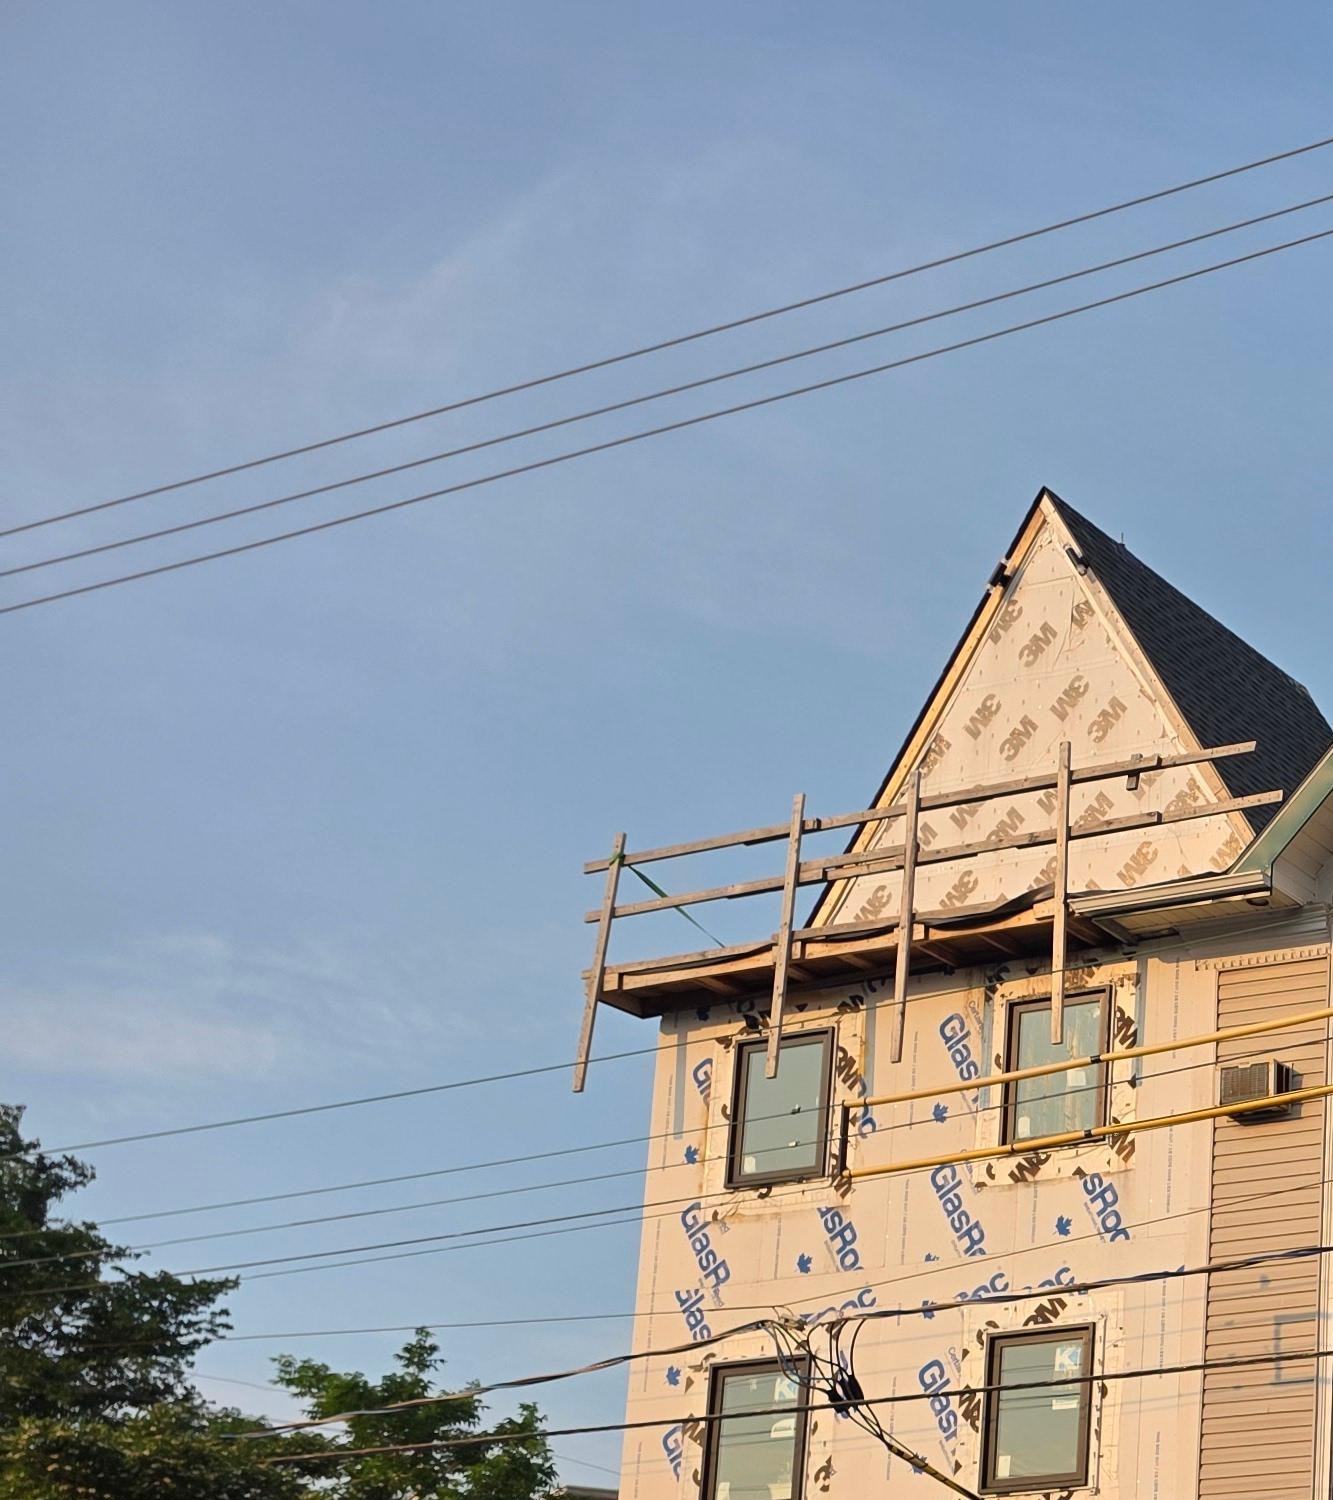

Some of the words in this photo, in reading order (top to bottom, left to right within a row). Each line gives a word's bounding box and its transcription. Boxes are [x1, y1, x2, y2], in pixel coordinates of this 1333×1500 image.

[1019, 621, 1058, 667] 3M
[963, 694, 1002, 741] 3M
[1050, 675, 1089, 722] 3M
[1088, 696, 1128, 743] 3M
[1000, 714, 1039, 761] 3M
